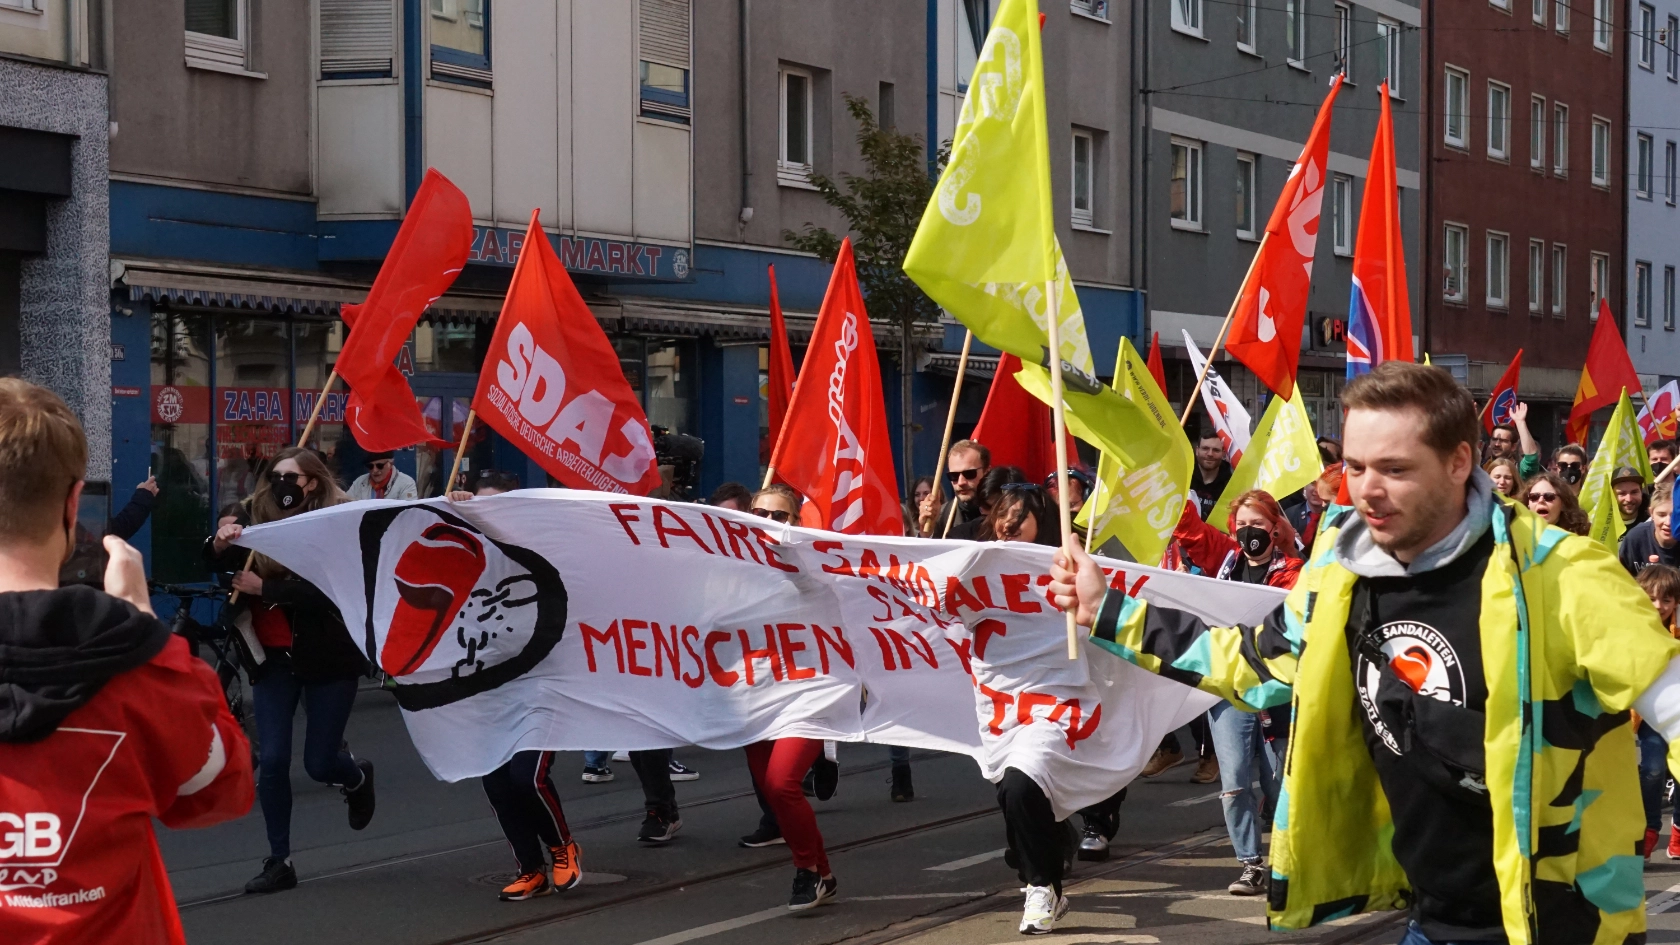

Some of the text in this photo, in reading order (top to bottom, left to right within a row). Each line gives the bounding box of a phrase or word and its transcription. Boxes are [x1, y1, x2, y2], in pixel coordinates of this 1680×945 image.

[561, 237, 661, 277] MARKT
[296, 392, 350, 421] MARK
[520, 421, 556, 458] DEUTSCHE
[609, 504, 799, 572] FAIRE
[578, 618, 855, 688] MENSCHEN
[868, 627, 939, 671] IN
[1383, 624, 1456, 668] SANDALETTEN
[1359, 686, 1378, 719] STATT
[4, 886, 106, 909] Mittelfranken
